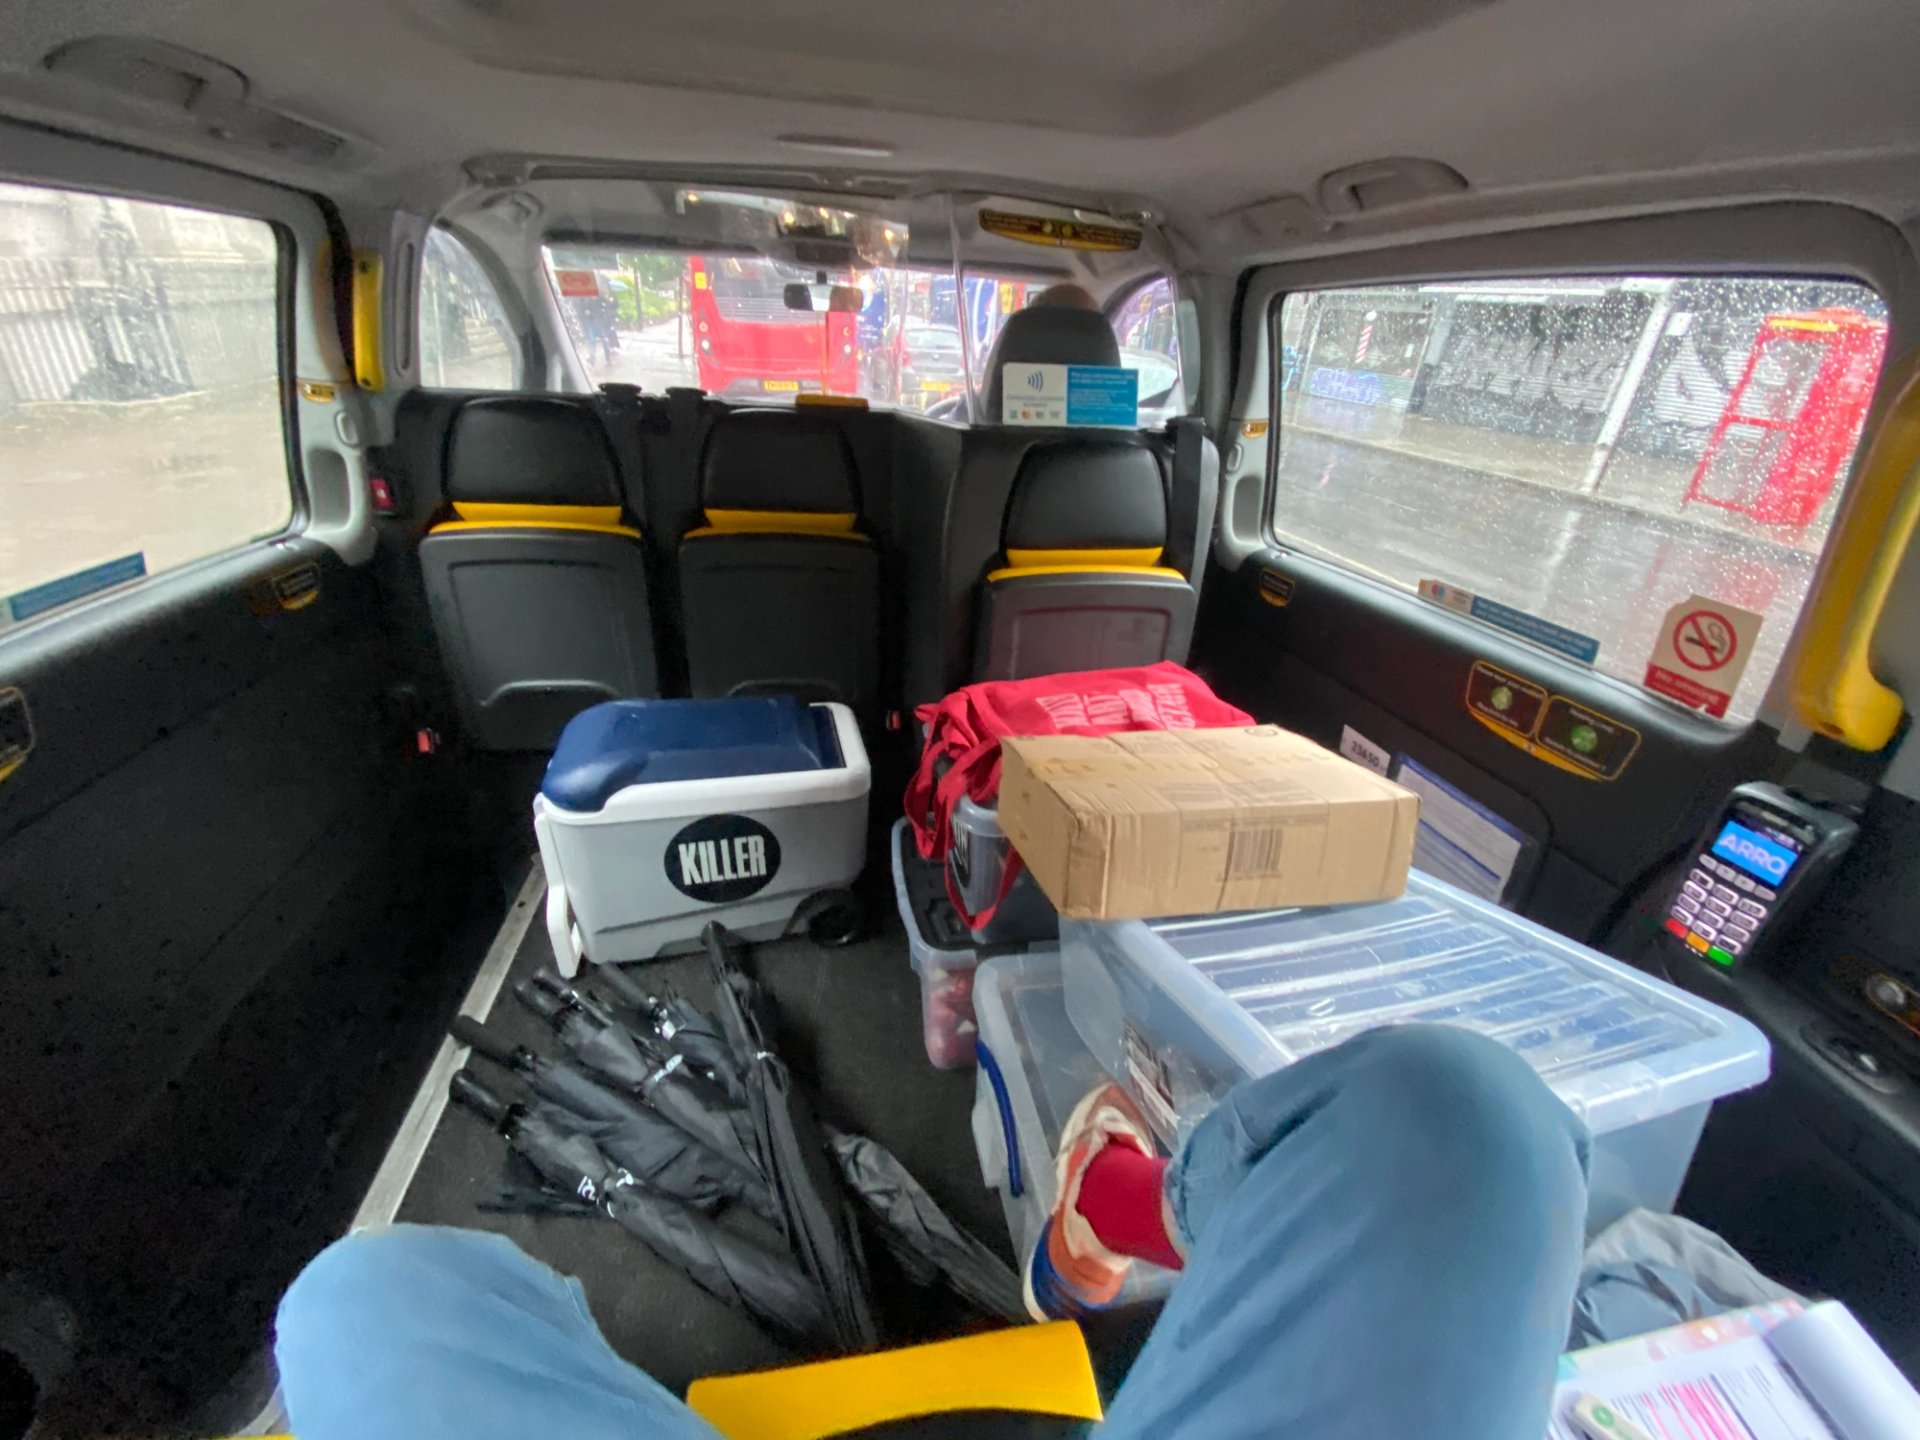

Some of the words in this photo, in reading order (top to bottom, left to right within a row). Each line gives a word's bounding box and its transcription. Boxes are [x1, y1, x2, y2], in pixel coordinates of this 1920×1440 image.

[1351, 740, 1380, 768] 23650
[678, 835, 767, 886] KILLER
[1719, 833, 1787, 875] ARRO
